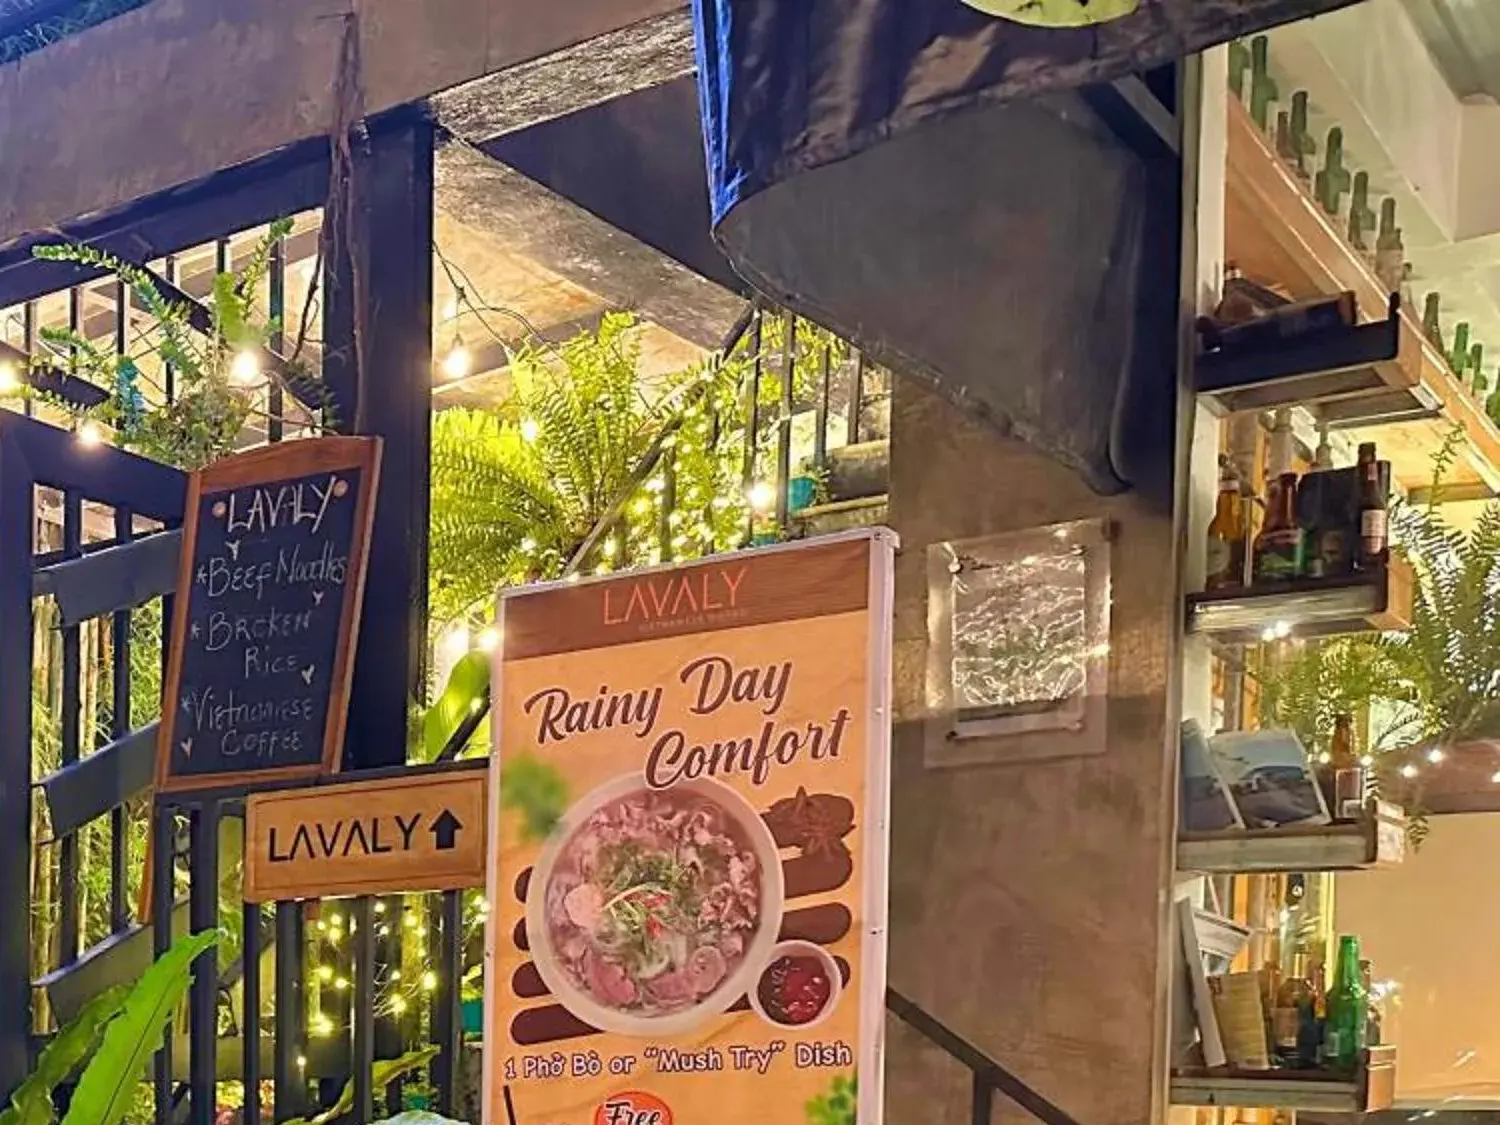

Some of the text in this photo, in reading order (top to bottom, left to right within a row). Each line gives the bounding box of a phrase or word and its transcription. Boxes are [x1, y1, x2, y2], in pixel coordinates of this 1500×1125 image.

[227, 475, 337, 534] LAVALY
[603, 567, 749, 625] LAVALY
[523, 655, 793, 746] Rainy Day
[645, 708, 852, 791] Comfort
[268, 814, 421, 862] LAVALY
[504, 1059, 517, 1080] 1
[609, 1056, 636, 1073] or
[795, 1041, 852, 1068] Dish
